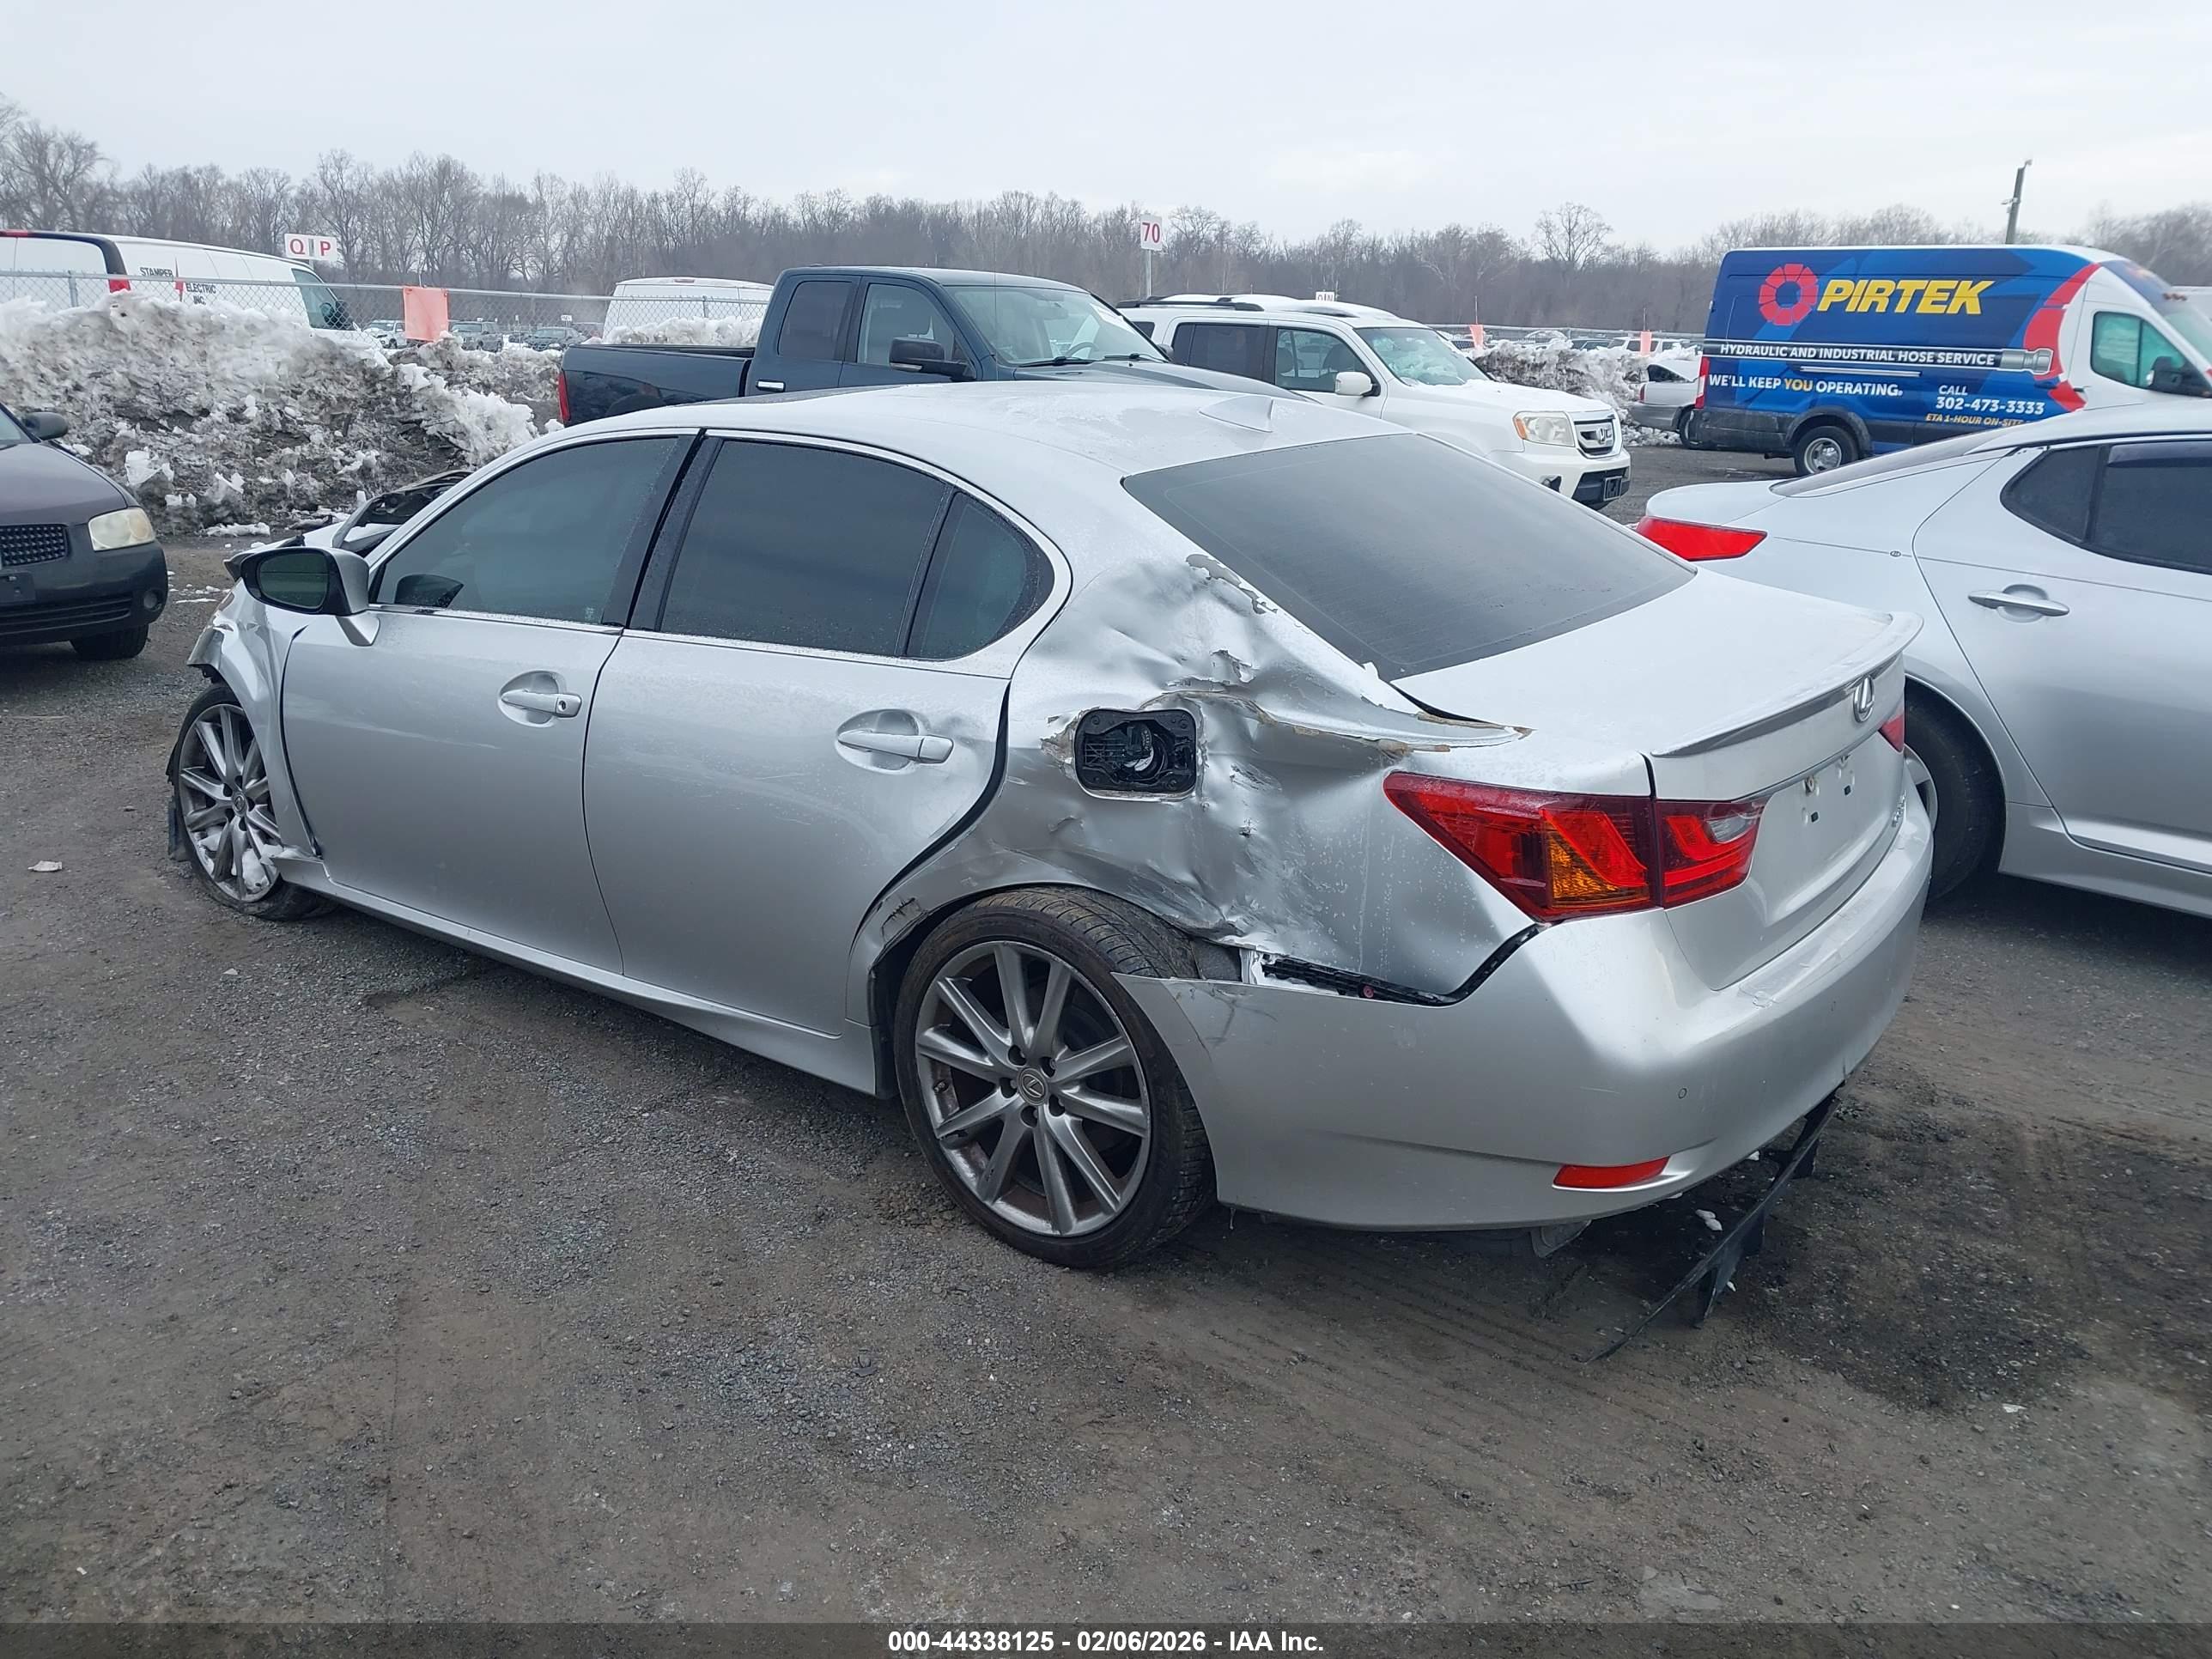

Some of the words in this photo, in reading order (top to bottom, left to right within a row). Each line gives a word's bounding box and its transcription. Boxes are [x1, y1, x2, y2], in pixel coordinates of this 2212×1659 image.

[1142, 222, 1160, 243] 70
[289, 238, 306, 255] Q
[319, 240, 331, 257] P
[139, 266, 174, 278] STAMPER
[185, 283, 216, 294] ELECTRIC
[1816, 279, 1996, 315] PIRTEK
[1720, 343, 1788, 358] HYDRAULIC
[1790, 347, 1816, 359] AND
[1819, 347, 1895, 362] INDUSTRIAL
[1897, 350, 1935, 363] HOSE
[1936, 352, 1996, 366] SERVICE
[1709, 374, 1746, 387] WE'LL
[1748, 376, 1782, 389] KEEP
[1784, 378, 1814, 392] YOU
[1938, 385, 1969, 396] CALL
[1935, 396, 2046, 416] 302-473-3333
[1925, 413, 1943, 422] ETA
[1943, 414, 1981, 424] 1-HOUR
